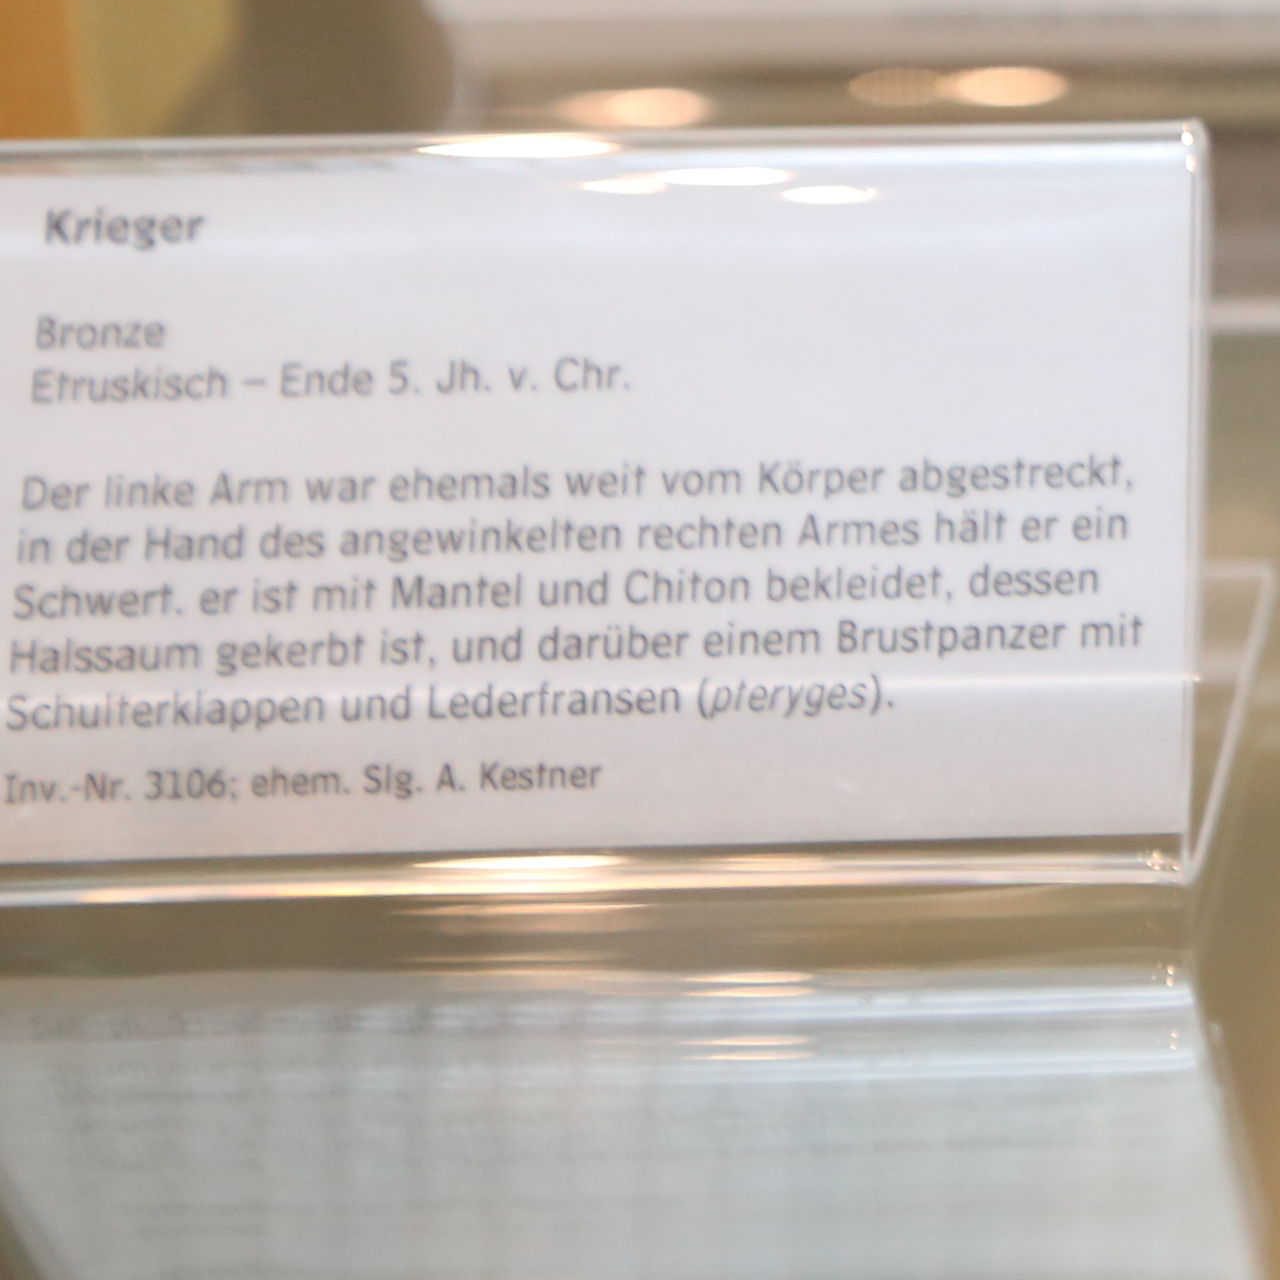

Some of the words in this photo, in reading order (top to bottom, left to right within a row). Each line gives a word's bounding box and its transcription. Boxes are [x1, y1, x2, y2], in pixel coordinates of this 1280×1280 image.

[44, 208, 205, 252] Krieger
[36, 316, 168, 351] Bronze
[30, 366, 229, 404] Etruskisch
[280, 362, 375, 398] Ende
[388, 360, 420, 396] 5.
[436, 359, 492, 395] Jh.
[508, 366, 536, 392] v.
[554, 356, 630, 392] Chr.
[21, 475, 90, 512] Der
[104, 474, 196, 508] linke
[210, 472, 290, 505] Arm
[305, 474, 376, 504] war
[389, 465, 551, 502] ehemals
[566, 462, 646, 498] weit
[662, 468, 742, 496] vom
[758, 460, 884, 499] Körper
[899, 454, 1133, 499] abgestreckt,
[16, 530, 52, 564] in
[66, 528, 131, 564] der
[144, 526, 246, 561] Hand
[258, 524, 326, 559] des
[339, 519, 622, 563] angewinkelten
[638, 516, 783, 550] rechten
[798, 513, 920, 547] Armes
[934, 510, 1006, 544] hält
[1020, 516, 1058, 542] er
[1072, 508, 1128, 542] ein
[13, 582, 184, 620] Schwert.
[198, 588, 239, 616] er
[252, 579, 298, 614] ist
[312, 576, 377, 612] mit
[391, 573, 523, 610] Mantel
[538, 571, 609, 607] und
[624, 569, 750, 605] Chiton
[766, 565, 952, 602] bekleidet,
[968, 563, 1100, 598] dessen
[10, 638, 201, 674] Halssaum
[215, 632, 366, 677] gekerbt
[380, 630, 436, 670] ist,
[452, 628, 523, 664] und
[538, 624, 690, 661] darüber
[703, 622, 821, 658] einem
[837, 619, 1066, 658] Brustpanzer
[1080, 614, 1144, 648] mit
[4, 692, 326, 732] Schulterklappen
[340, 686, 412, 722] und
[428, 680, 682, 720] Lederfransen
[696, 673, 894, 720] (pteryges).
[4, 772, 131, 805] Inv.-Nr.
[144, 766, 238, 802] 3106;
[250, 766, 350, 798] ehem.
[364, 763, 422, 800] Slg.
[436, 762, 464, 792] A.
[480, 760, 602, 791] Kestner
